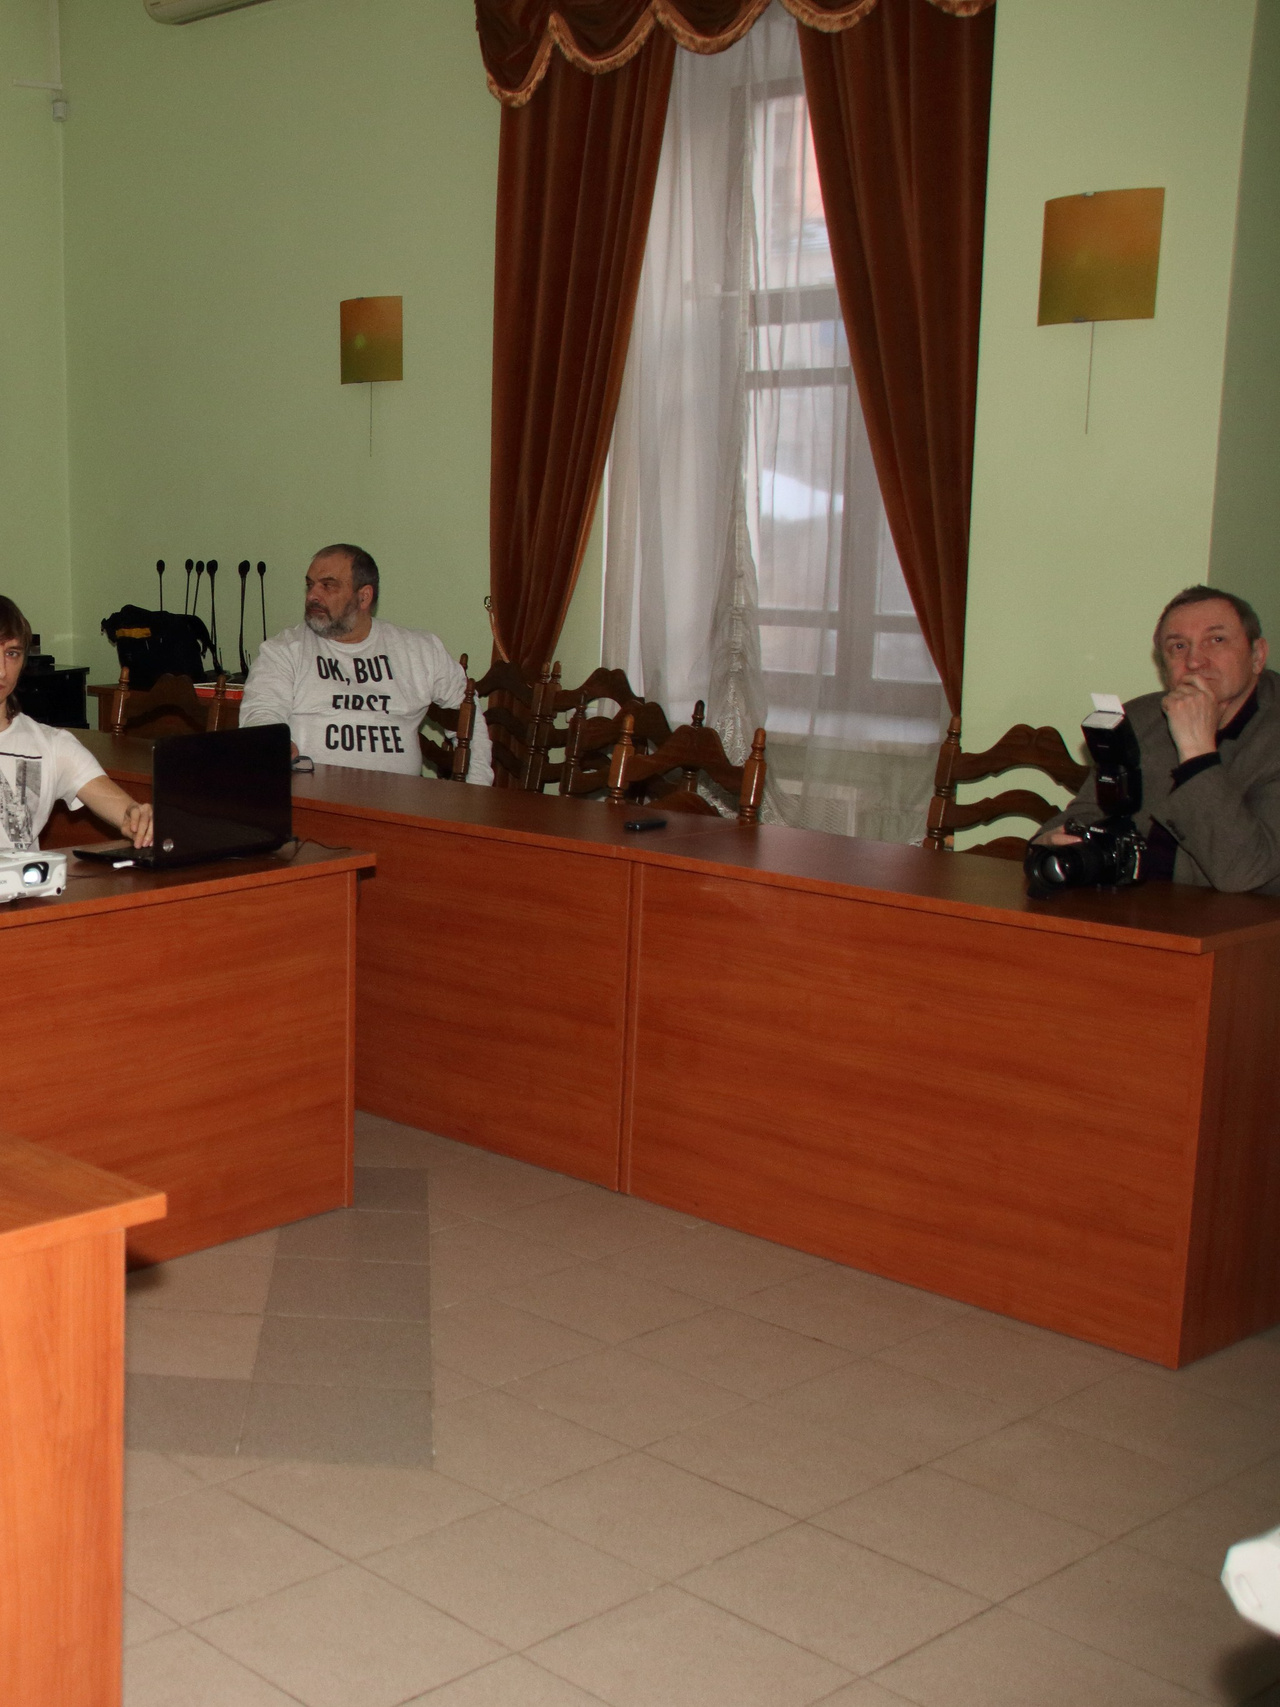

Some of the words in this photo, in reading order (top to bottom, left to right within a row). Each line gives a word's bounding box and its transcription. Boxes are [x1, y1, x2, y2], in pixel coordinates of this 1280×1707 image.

[317, 655, 351, 686] OK,
[353, 654, 393, 684] BUT
[325, 724, 404, 753] COFFEE
